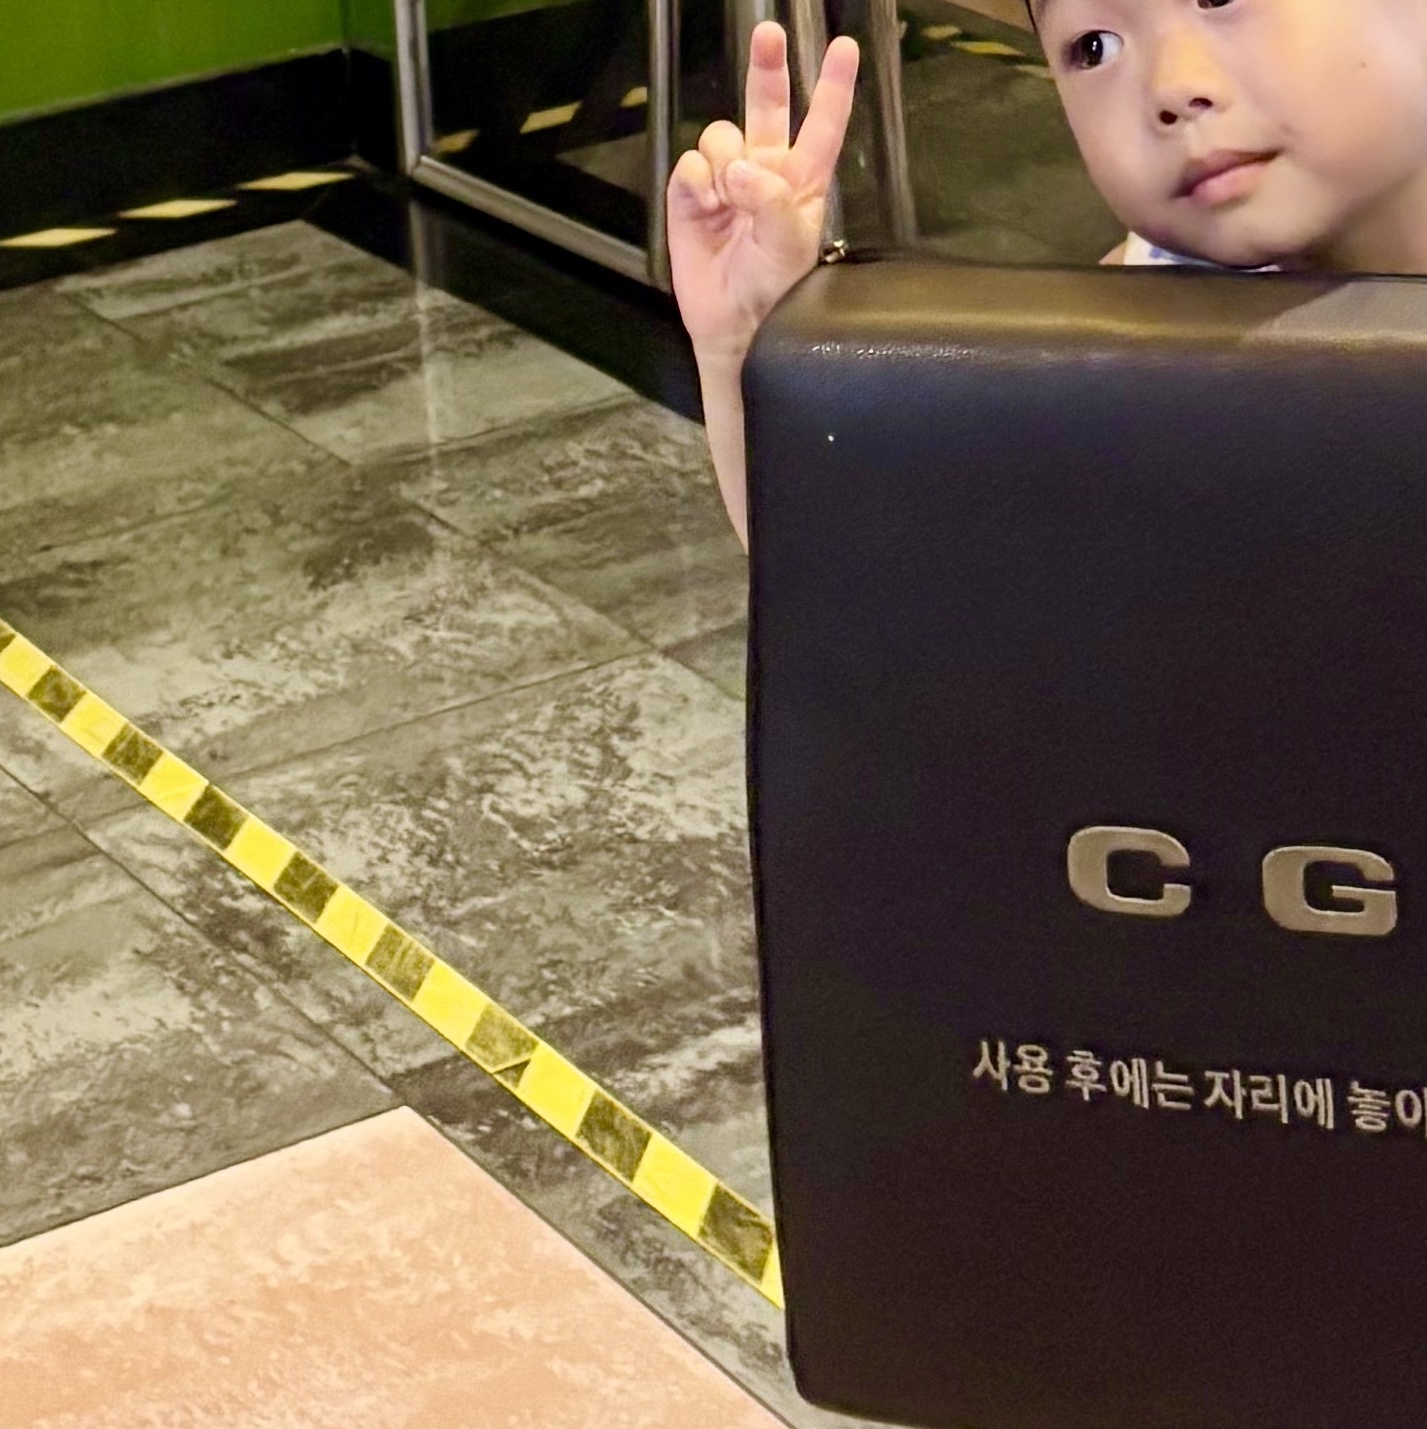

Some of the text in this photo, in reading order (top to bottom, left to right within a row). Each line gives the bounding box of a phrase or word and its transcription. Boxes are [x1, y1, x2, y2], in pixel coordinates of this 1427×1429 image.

[972, 1038, 1054, 1094] 사용
[1065, 1049, 1196, 1111] 후에는
[1203, 1069, 1335, 1129] 자리에
